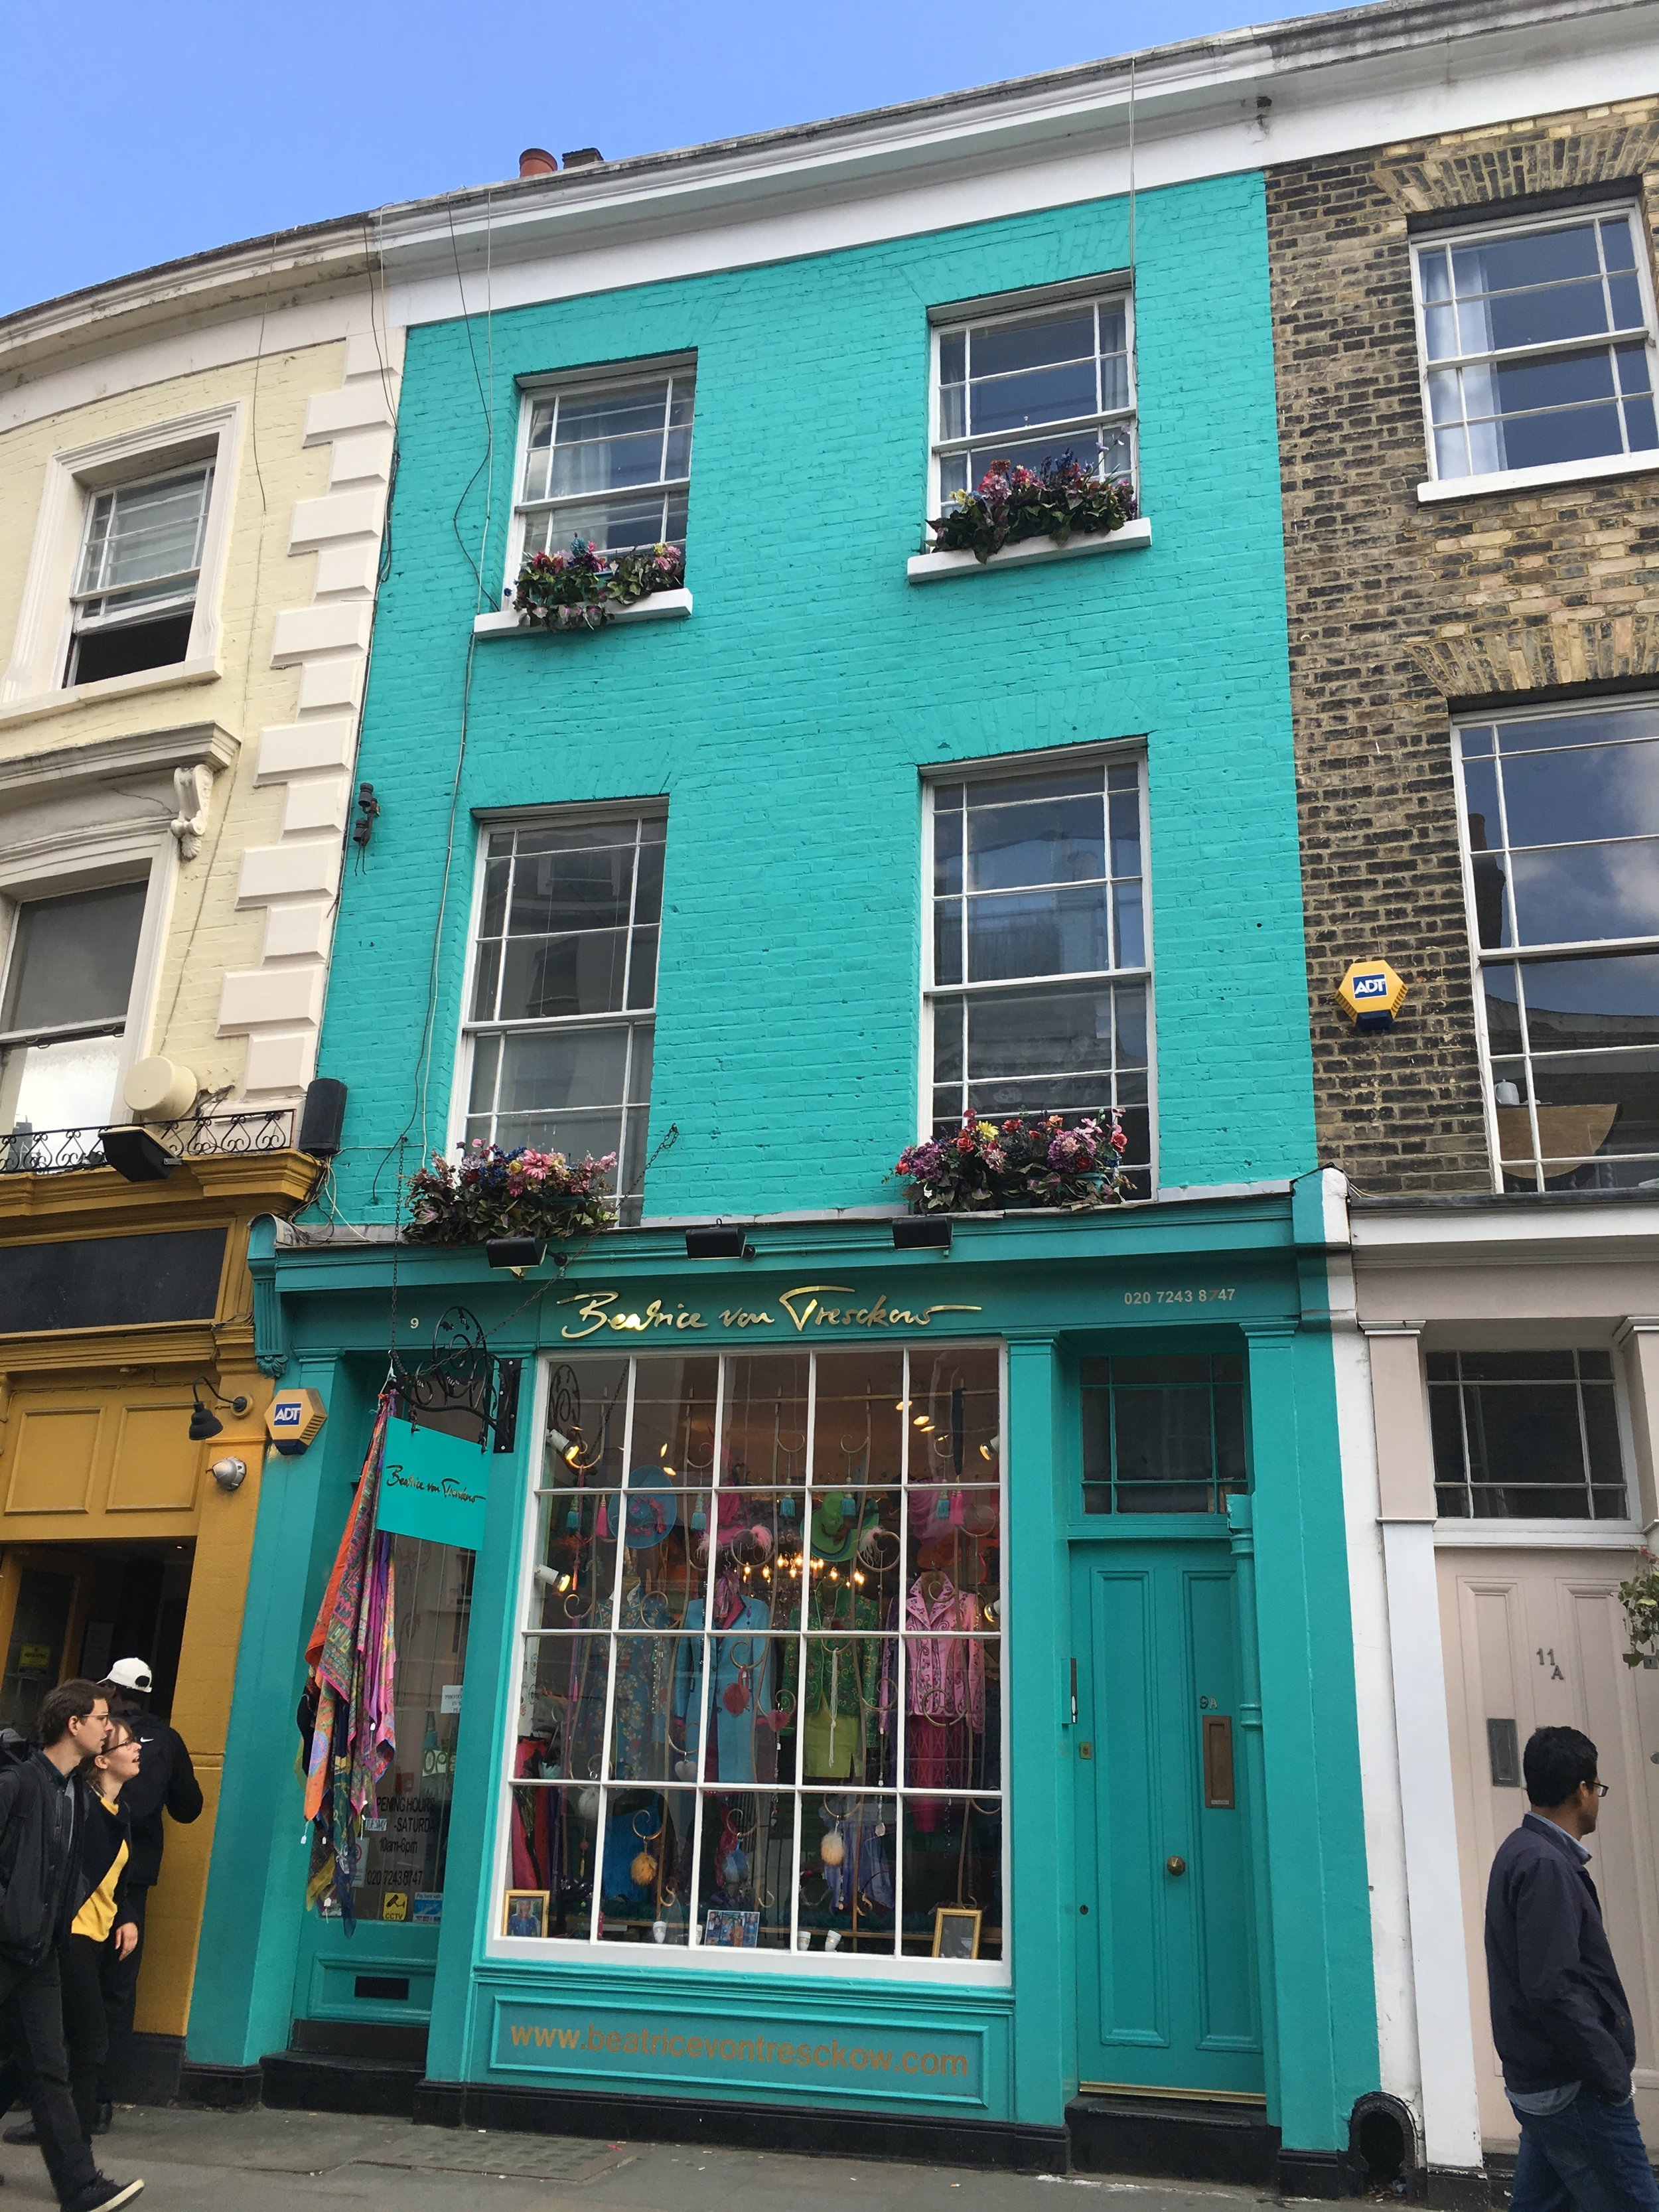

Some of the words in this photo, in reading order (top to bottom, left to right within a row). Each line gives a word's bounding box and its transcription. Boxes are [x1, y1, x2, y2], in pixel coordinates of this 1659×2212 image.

[1354, 978, 1386, 994] ADT
[1124, 1291, 1151, 1305] 020
[1156, 1290, 1193, 1303] 7243
[1198, 1288, 1236, 1302] 8747
[556, 1290, 709, 1339] Beatrice
[718, 1307, 775, 1328] von
[779, 1285, 982, 1332] Tresckow
[410, 1317, 419, 1329] 9
[273, 1407, 302, 1421] ADT
[386, 1464, 425, 1490] Beatrice
[1536, 1648, 1555, 1666] 11
[1551, 1664, 1564, 1680] A
[1199, 1695, 1218, 1710] 9A
[423, 1749, 457, 1774] OPE
[376, 1797, 405, 1812] PENING
[367, 1870, 381, 1885] 020
[383, 1870, 401, 1886] 7243
[402, 1871, 423, 1886] 8747
[510, 2023, 968, 2077] www.beatricevontresckow.com
